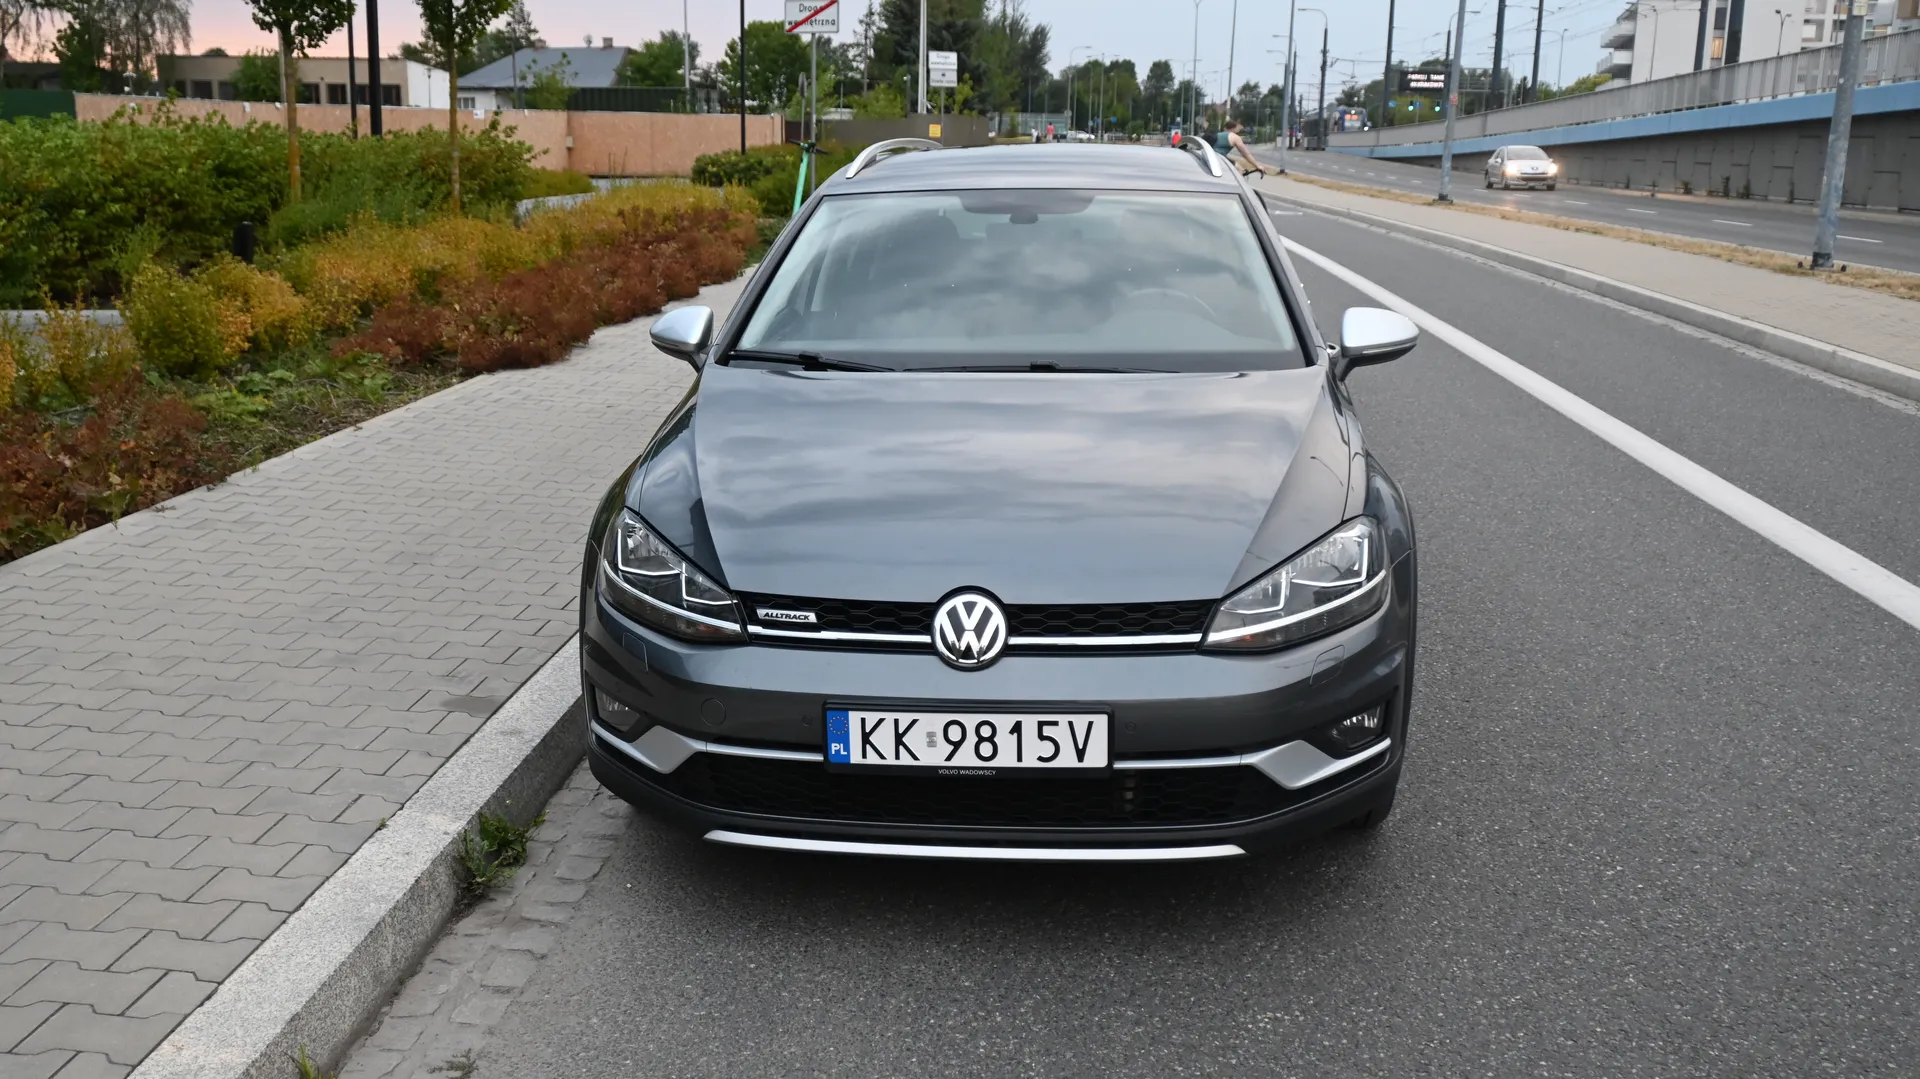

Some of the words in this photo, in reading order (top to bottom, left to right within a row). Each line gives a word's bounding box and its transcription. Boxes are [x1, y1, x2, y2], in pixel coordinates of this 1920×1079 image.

[788, 17, 836, 27] wenętrzna
[763, 612, 810, 620] ALLTRACK
[860, 717, 921, 761] KK
[942, 719, 1095, 763] 9815V
[831, 743, 848, 755] PL
